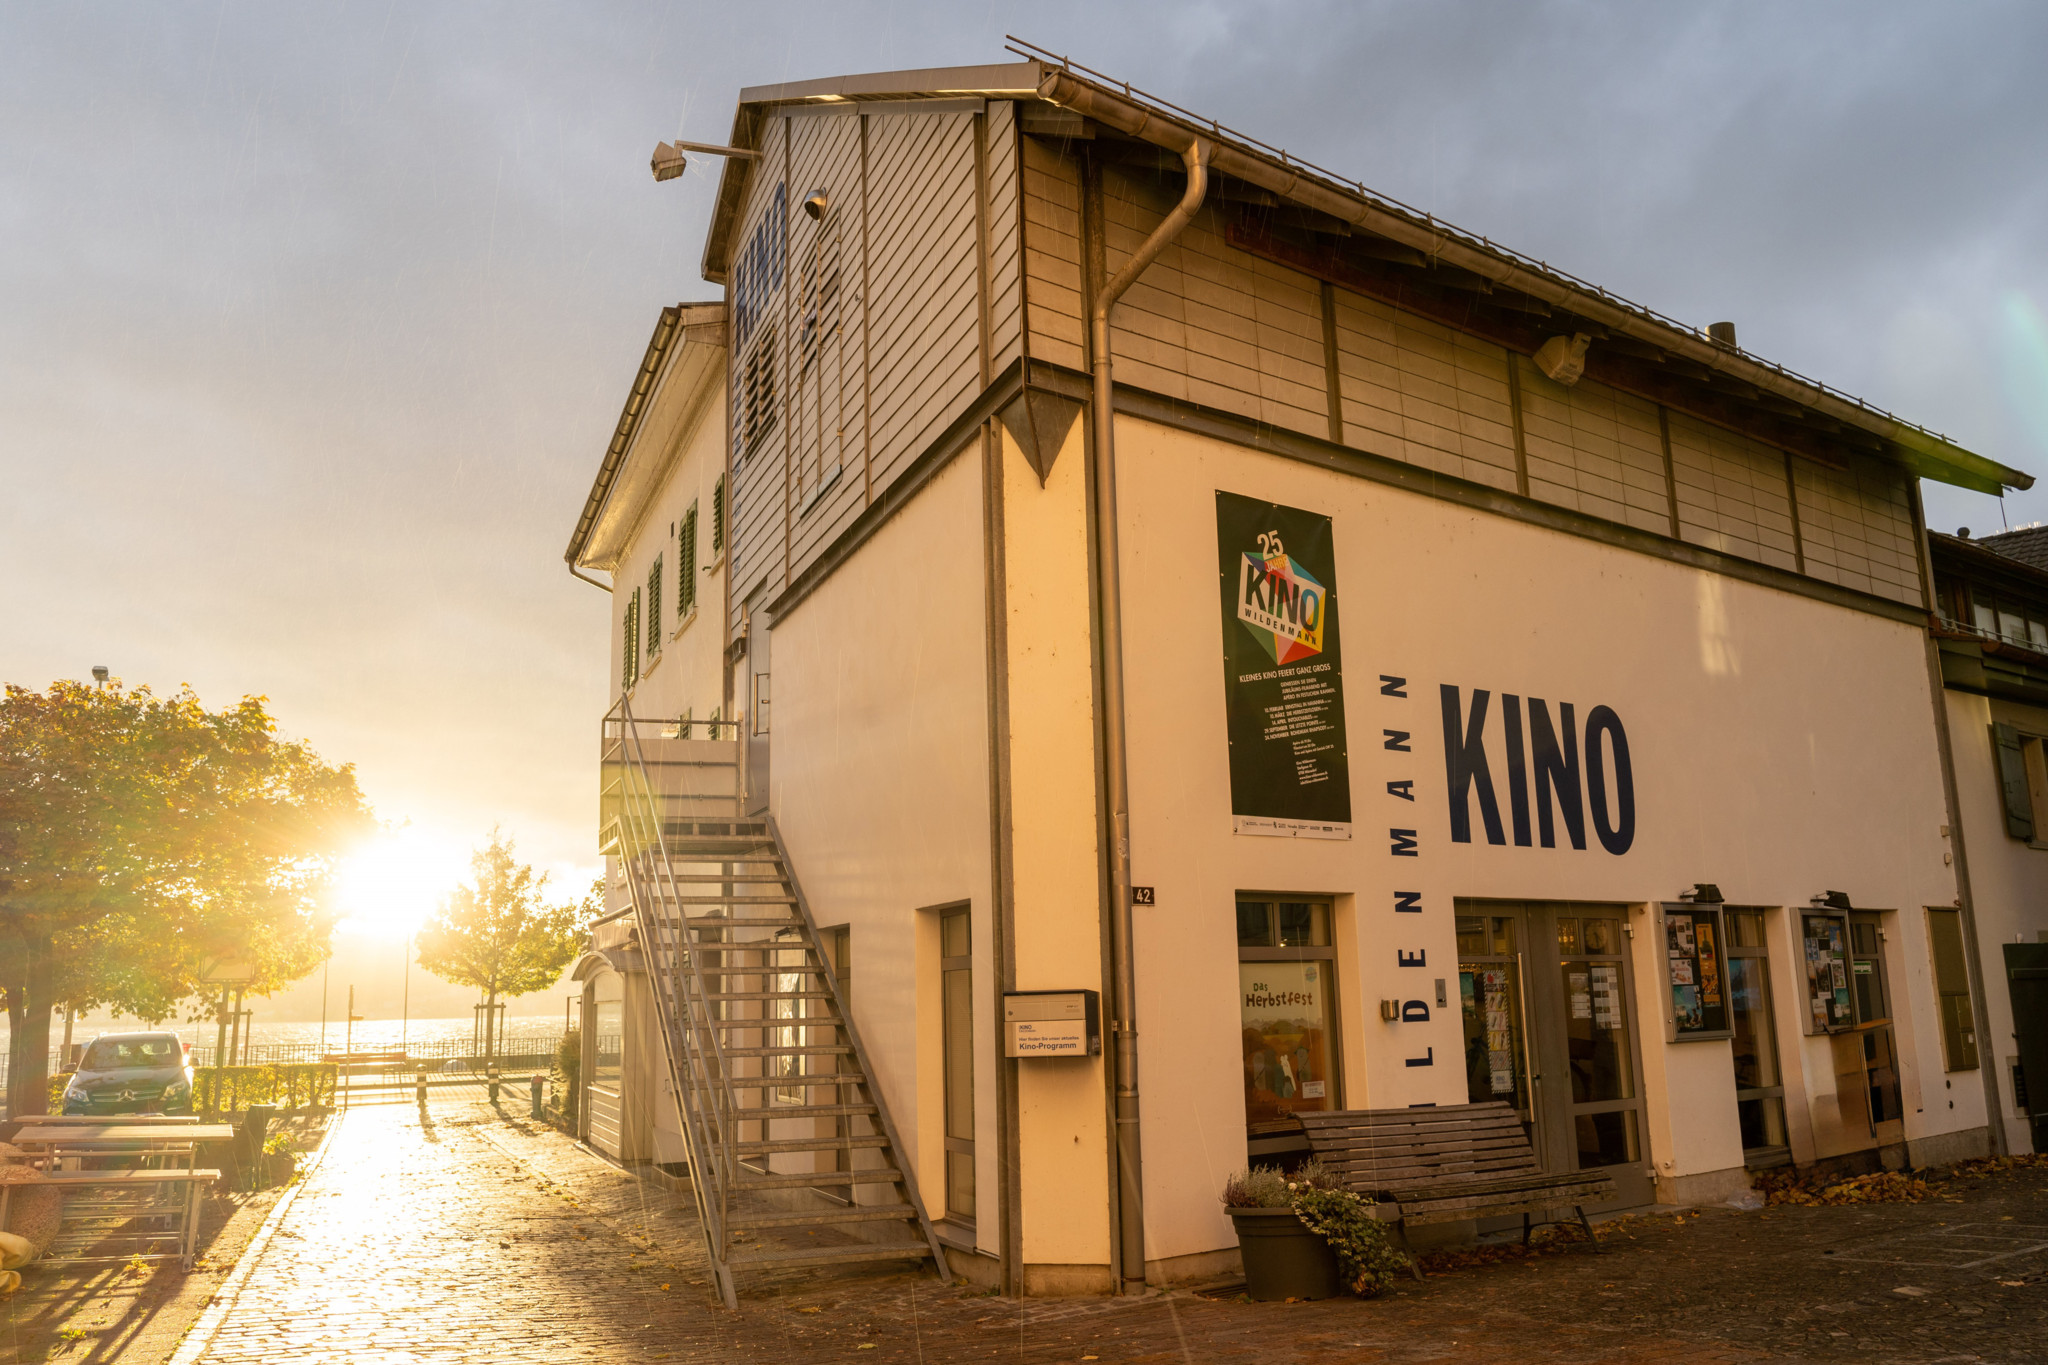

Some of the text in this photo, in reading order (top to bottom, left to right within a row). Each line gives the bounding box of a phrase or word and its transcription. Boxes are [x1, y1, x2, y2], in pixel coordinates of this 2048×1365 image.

[735, 180, 786, 360] KINO
[1257, 530, 1284, 560] 25
[1245, 563, 1319, 632] KINO
[1244, 608, 1317, 645] WILDENMANN
[1239, 663, 1331, 683] KLEINES KINO FEIERT GANZ GROSS
[1440, 684, 1635, 856] KINO
[1136, 888, 1151, 903] 42
[1246, 991, 1313, 1008] Herbstfest
[1253, 982, 1268, 992] Das
[1019, 1042, 1077, 1051] Kino-Programm
